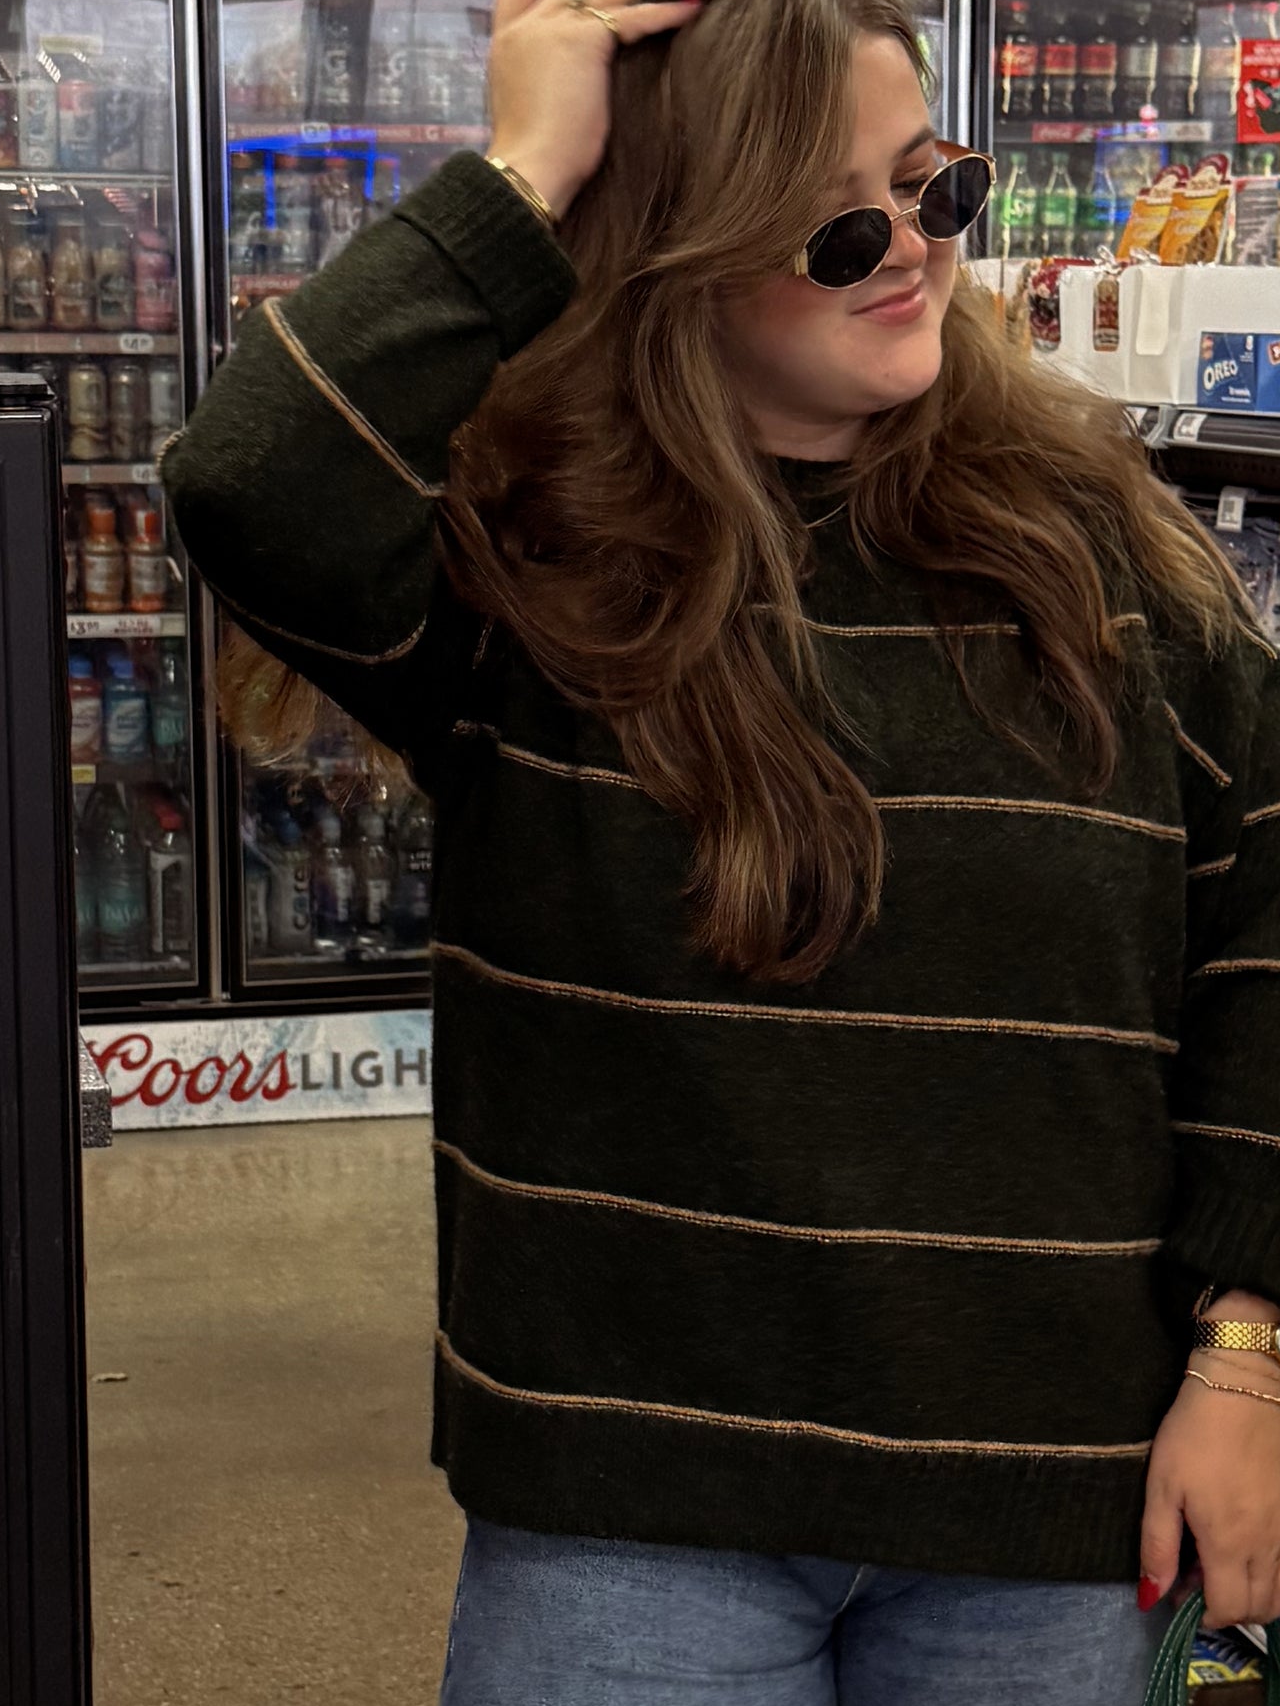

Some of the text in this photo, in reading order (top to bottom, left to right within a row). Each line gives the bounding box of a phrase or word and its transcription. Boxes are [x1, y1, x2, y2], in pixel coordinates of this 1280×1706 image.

[1203, 359, 1239, 391] OREO
[83, 1032, 428, 1108] Coors LIGH
